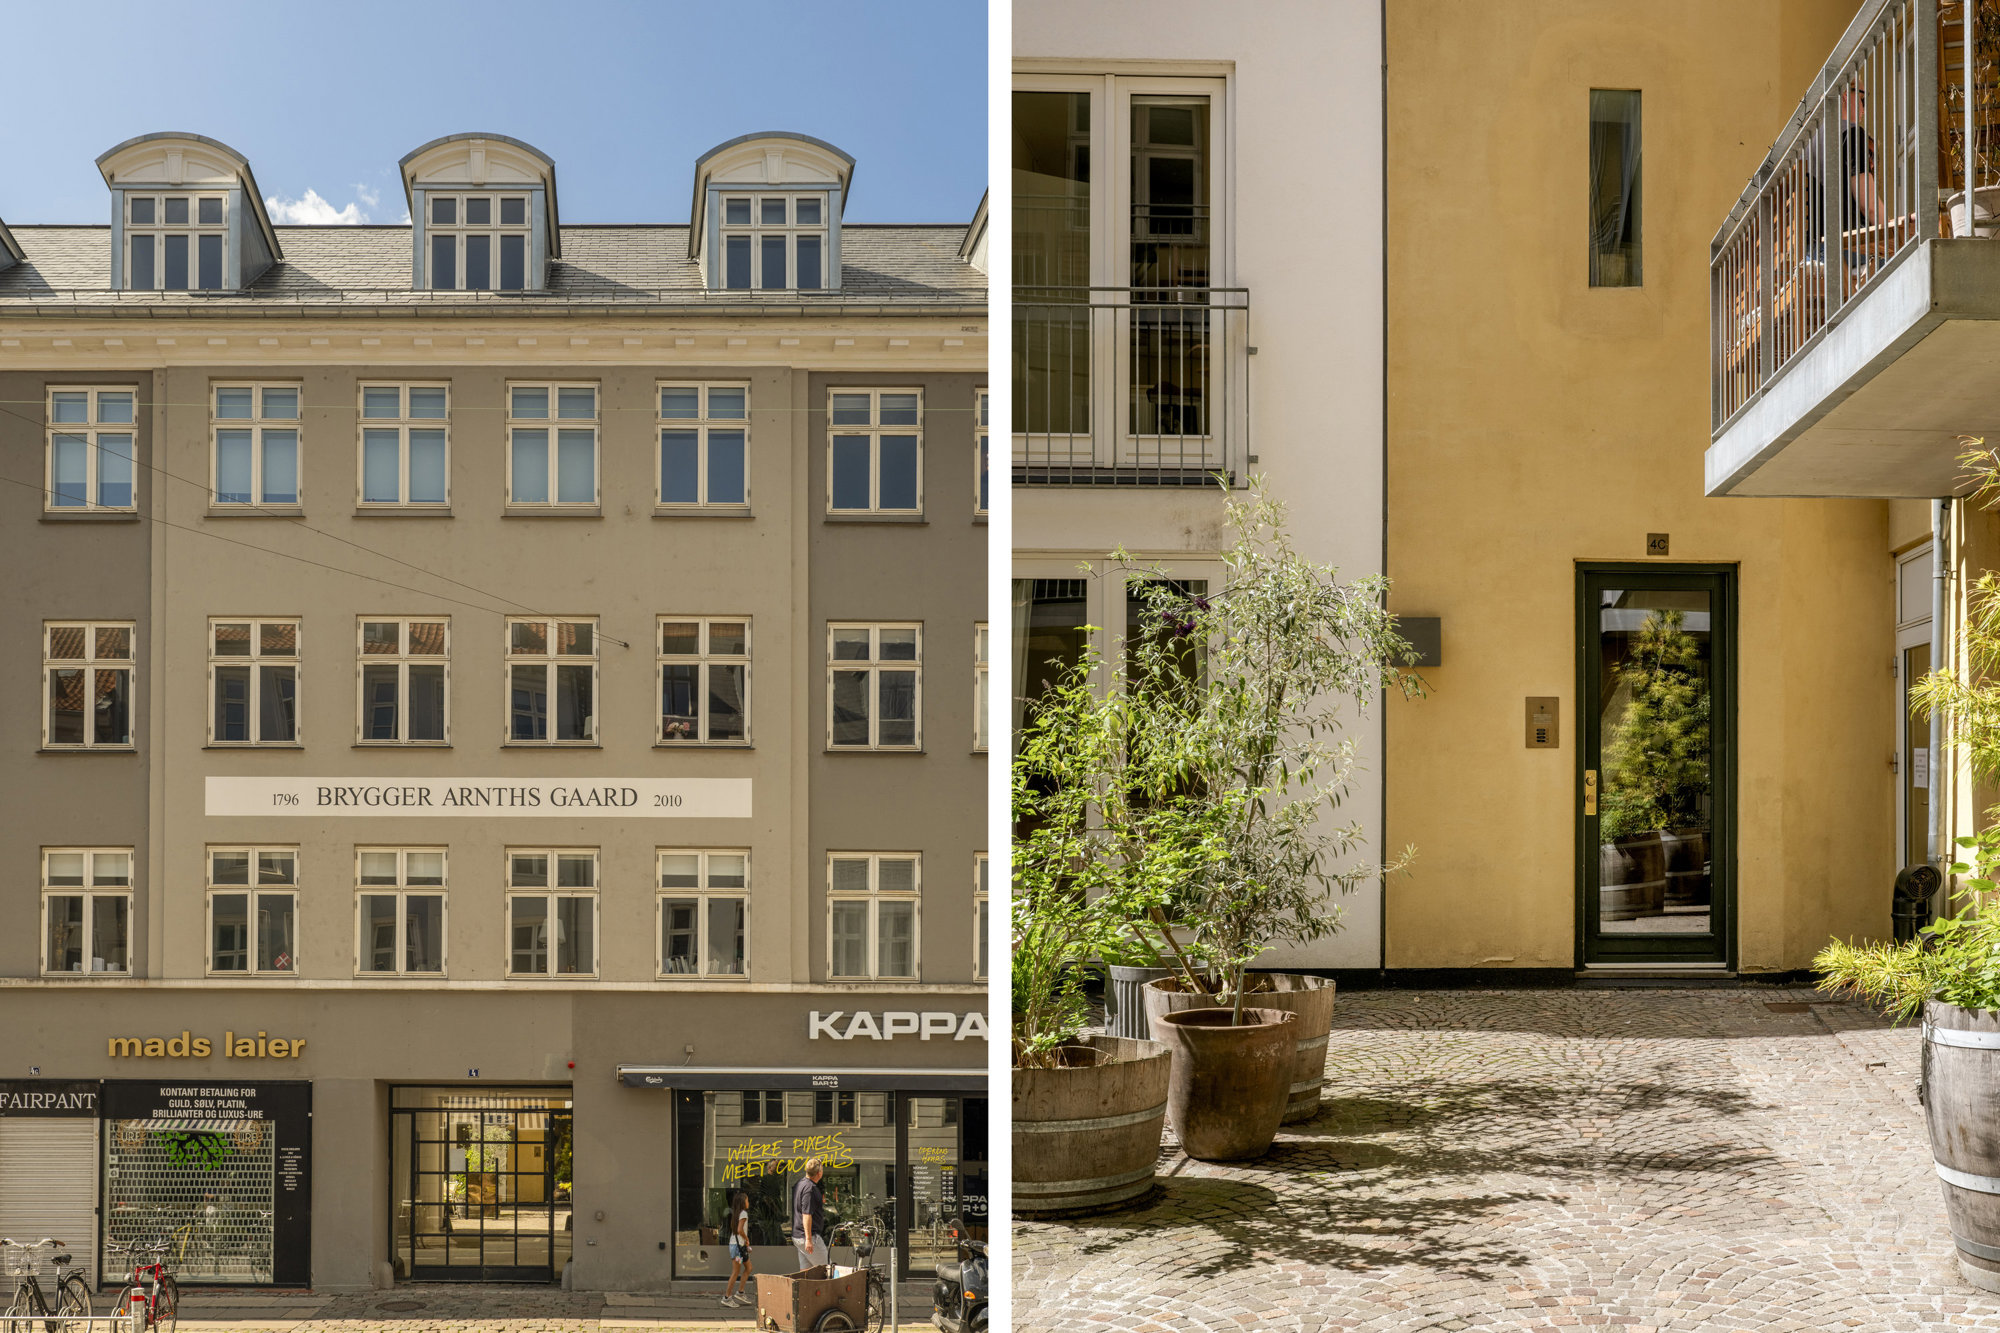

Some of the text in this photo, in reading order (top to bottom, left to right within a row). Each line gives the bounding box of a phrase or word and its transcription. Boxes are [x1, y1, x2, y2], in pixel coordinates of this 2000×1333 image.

[1650, 539, 1666, 550] 4C
[273, 787, 682, 807] 1796 BRYGGER ARNTHS GAARD 2010
[809, 1010, 988, 1041] KAPPA
[108, 1031, 306, 1058] mads laier
[0, 1092, 97, 1109] FAIRPANT
[160, 1087, 256, 1097] KONTANT BETALING FOR
[168, 1099, 247, 1109] GULD, SØLV, PLATIN,
[152, 1109, 264, 1119] BRILLIANTER OG LUXUS-URE
[728, 1132, 845, 1163] WHERE PIXELS
[722, 1159, 770, 1182] MEET
